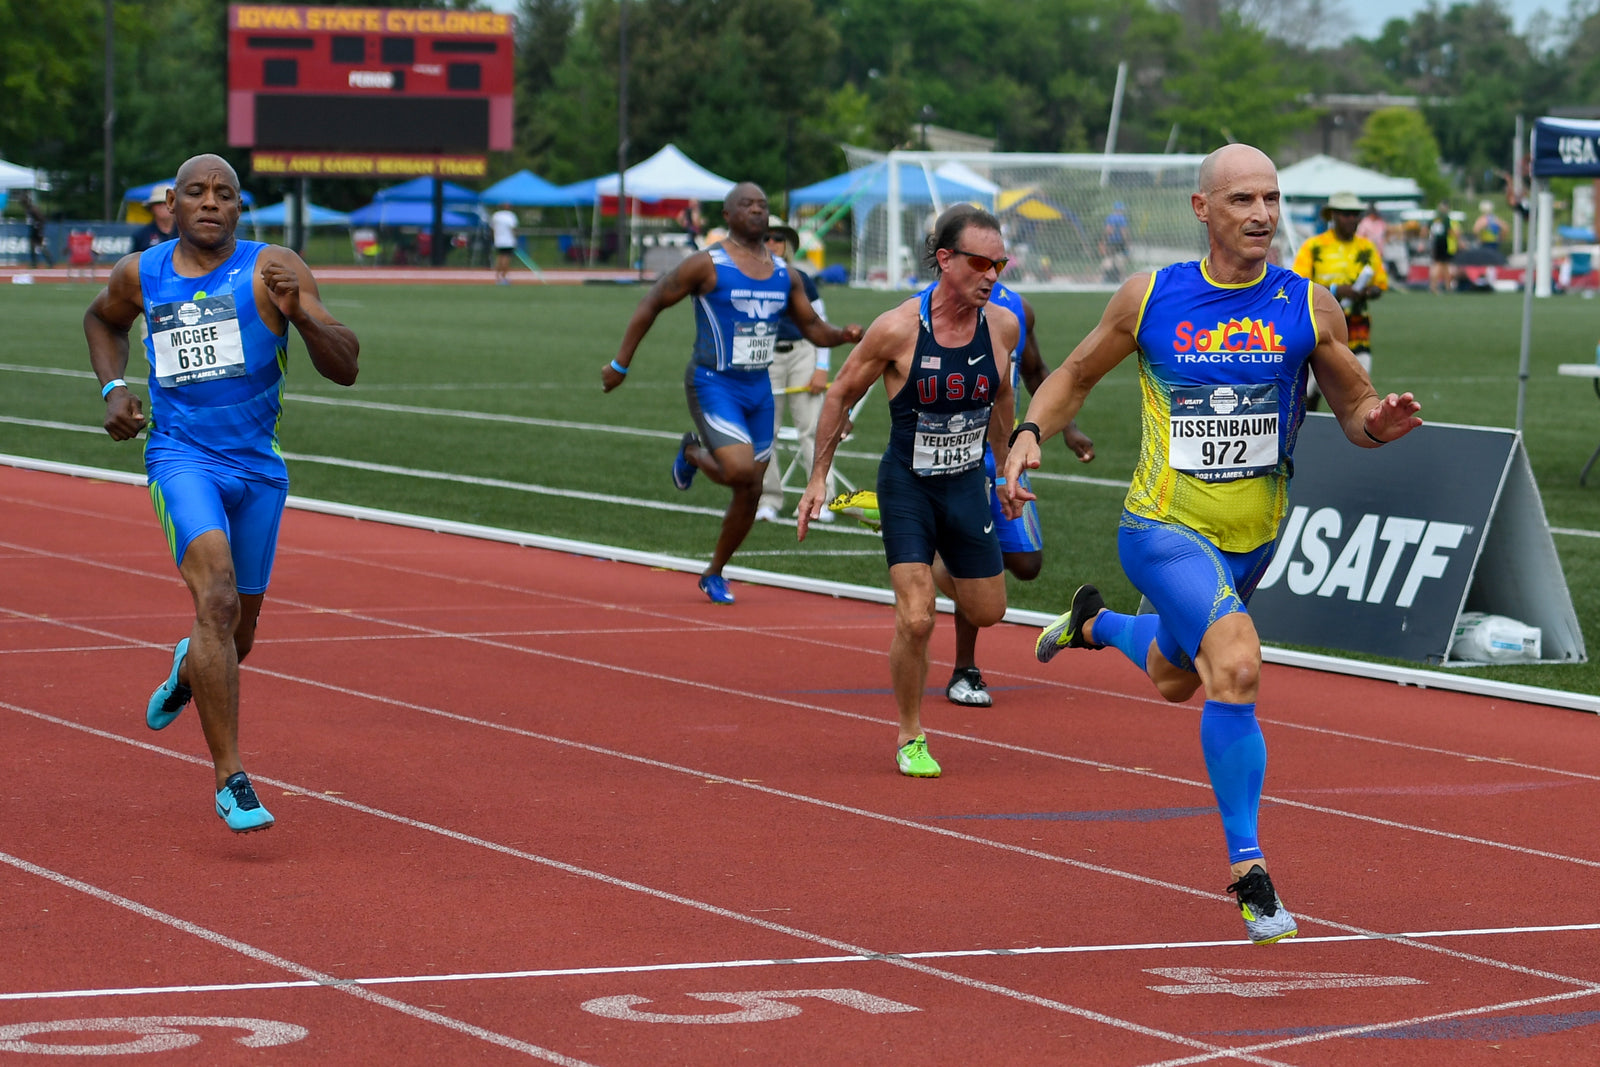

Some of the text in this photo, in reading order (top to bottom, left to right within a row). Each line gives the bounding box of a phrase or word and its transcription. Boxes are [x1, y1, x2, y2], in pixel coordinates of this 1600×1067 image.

[237, 7, 507, 34] IOWA STATE CYCLONES
[348, 70, 395, 89] PERIOD
[288, 156, 321, 173] AND
[437, 158, 485, 176] TRACK
[170, 326, 219, 348] MCGEE
[1223, 321, 1287, 353] CAL
[177, 345, 217, 370] 638
[1174, 354, 1284, 363] TRACK CLUB
[916, 373, 990, 405] USA
[921, 430, 983, 448] YELVERTON
[1170, 417, 1277, 438] TISSENBAUM
[931, 446, 972, 467] 1045
[1201, 440, 1248, 466] 972
[1194, 472, 1213, 480] 2021
[1141, 966, 1430, 998] 4
[580, 988, 925, 1024] 5
[0, 1016, 309, 1056] 6
